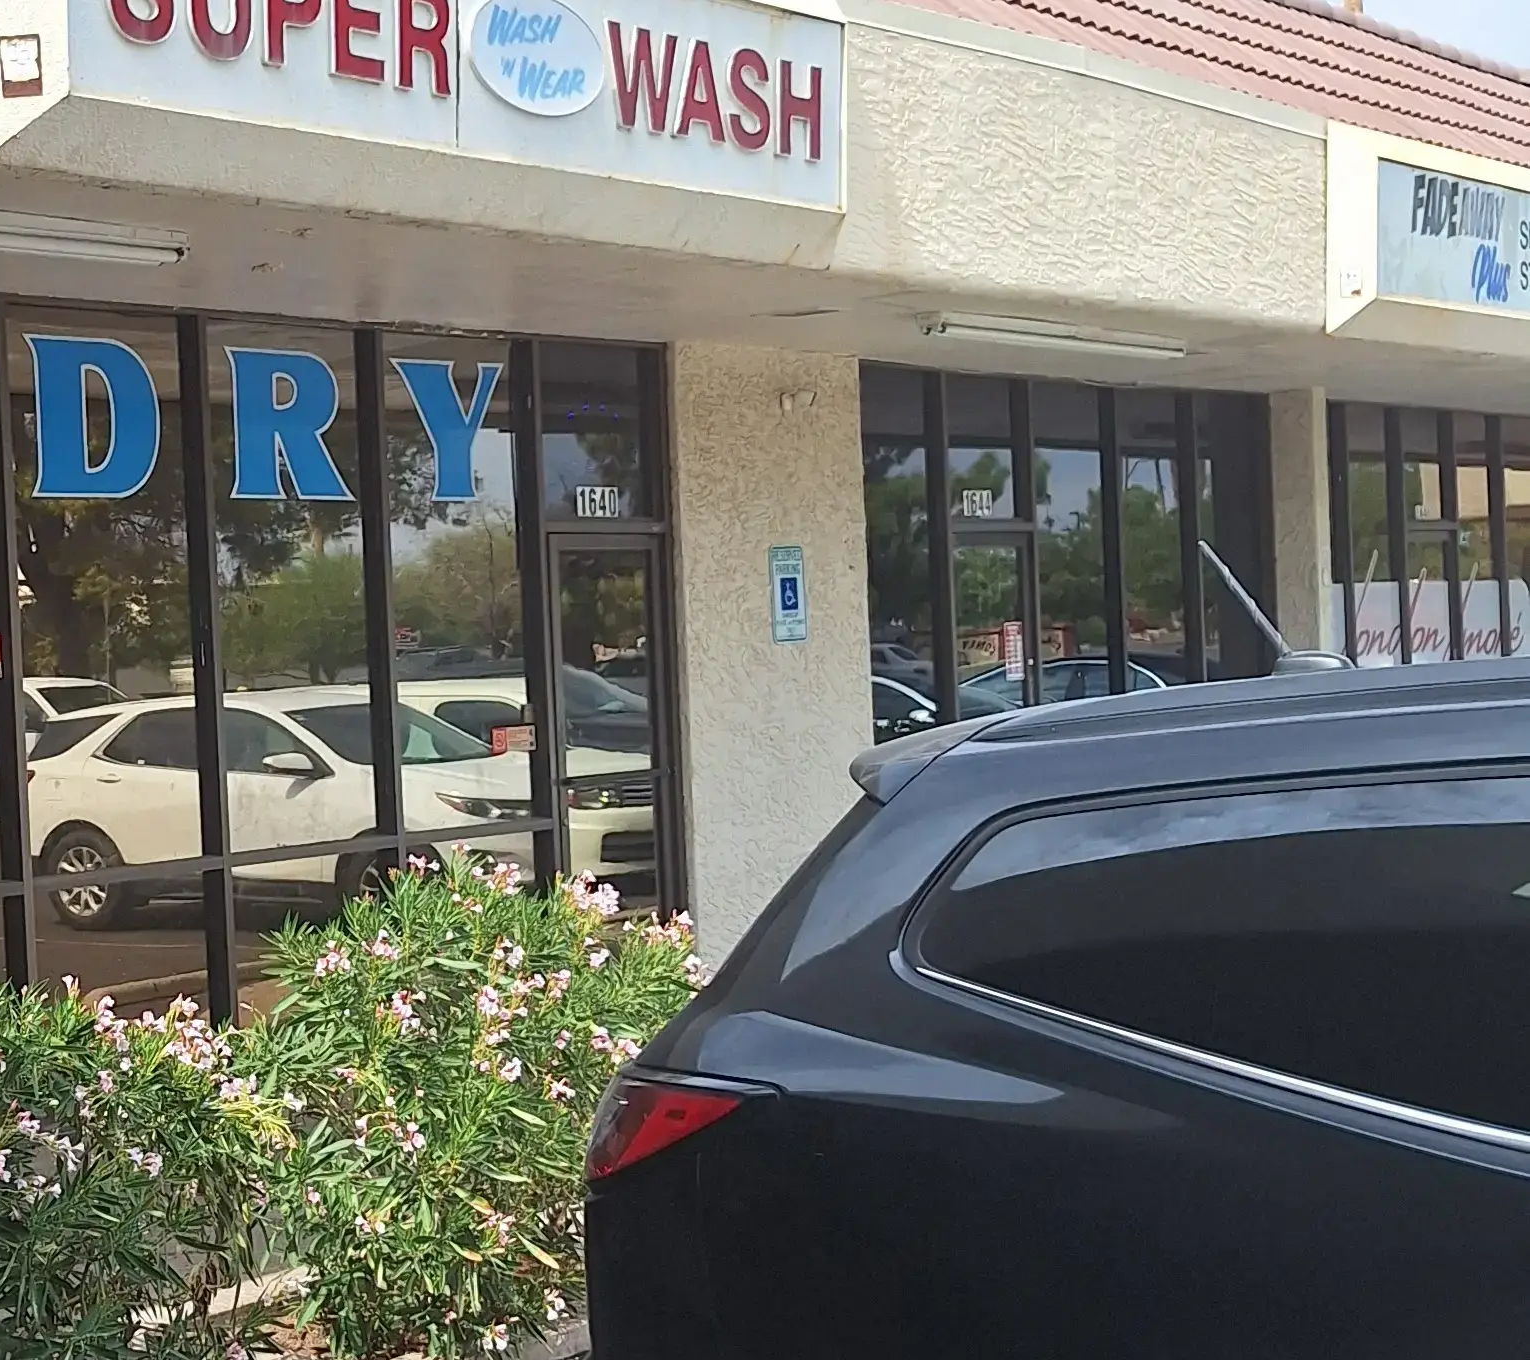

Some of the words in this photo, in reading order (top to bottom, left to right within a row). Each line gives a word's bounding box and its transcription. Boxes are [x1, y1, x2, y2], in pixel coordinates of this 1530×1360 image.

[487, 4, 562, 47] WASH
[518, 56, 585, 103] WEAR
[606, 18, 822, 161] WASH
[578, 488, 617, 517] 1640
[964, 491, 992, 515] 1644
